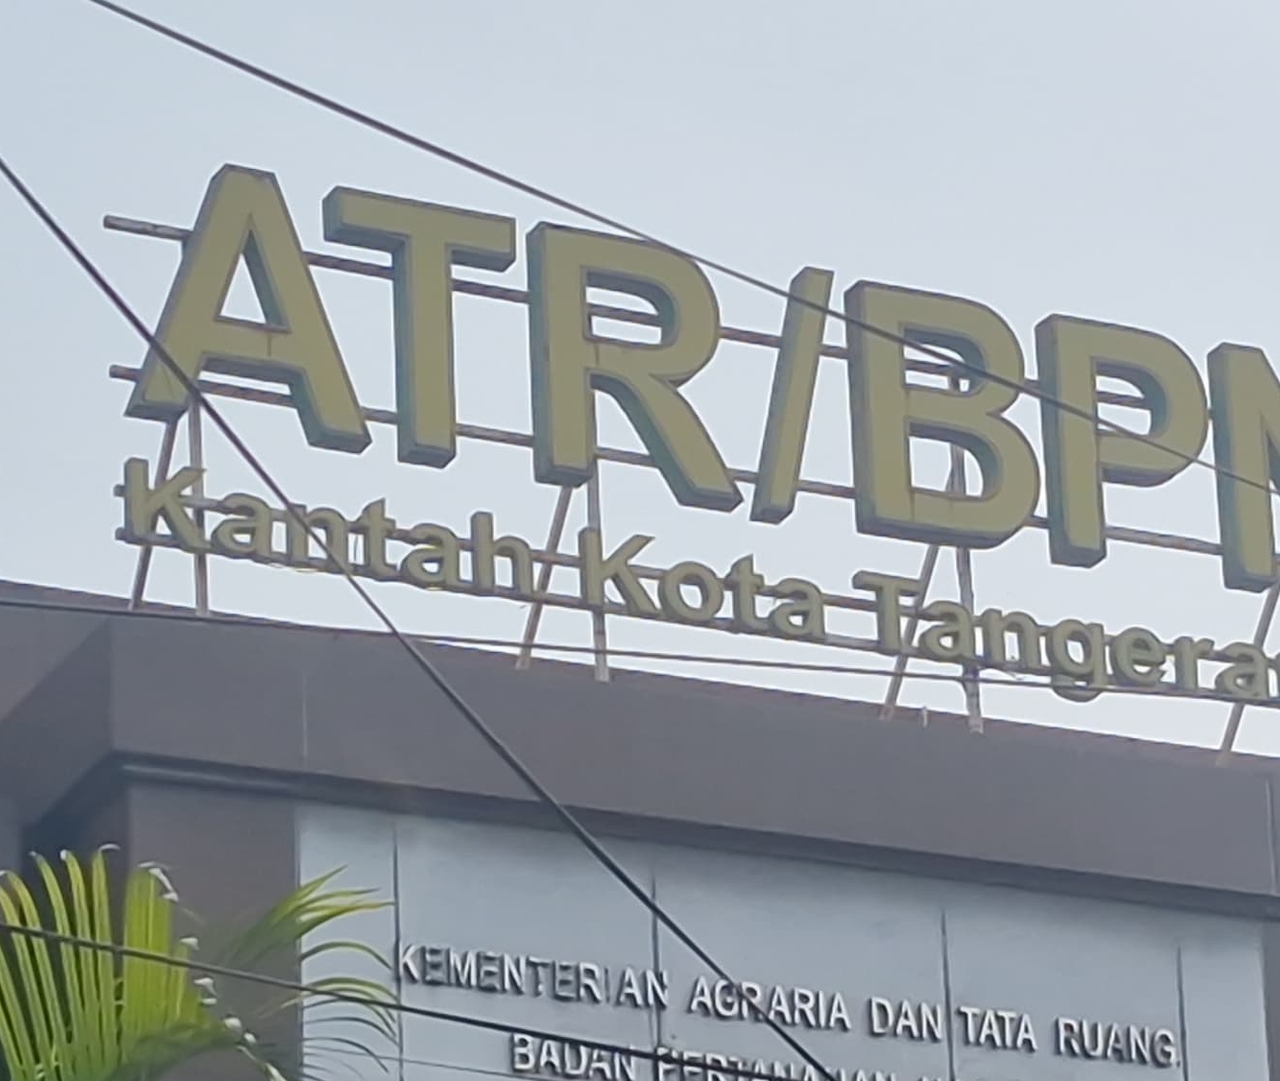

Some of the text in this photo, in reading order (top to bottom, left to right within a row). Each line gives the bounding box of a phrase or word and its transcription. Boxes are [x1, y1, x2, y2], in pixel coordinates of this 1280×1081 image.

[124, 458, 535, 598] Kantah
[579, 528, 825, 638] Kota
[399, 943, 1179, 1069] KEMENTERIAN AGRARIA DAN TATA RUANG
